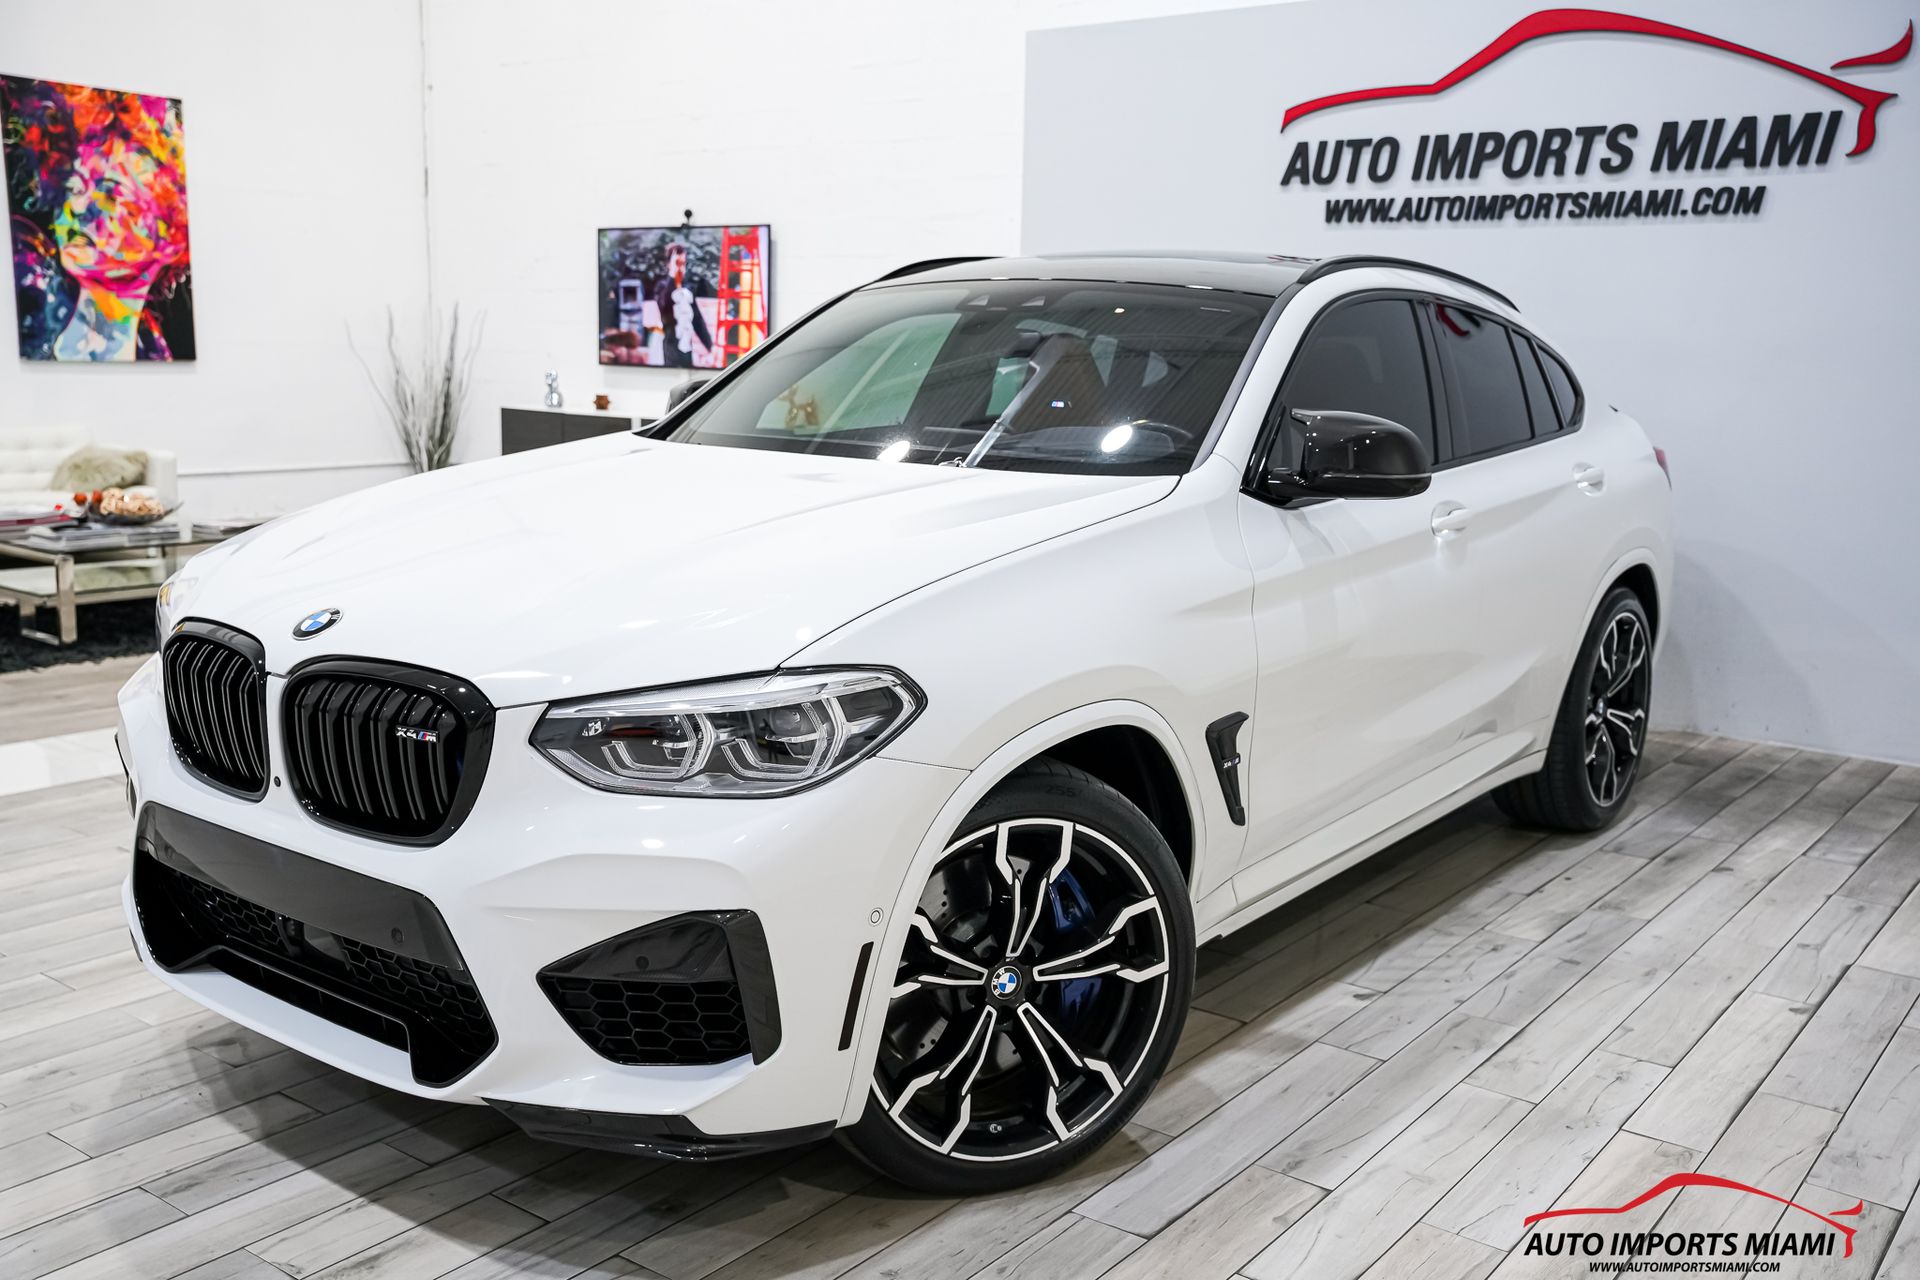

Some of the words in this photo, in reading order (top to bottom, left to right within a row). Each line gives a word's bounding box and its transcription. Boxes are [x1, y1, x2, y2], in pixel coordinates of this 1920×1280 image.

[1281, 137, 1399, 185] AUTO
[1411, 124, 1637, 181] IMPORTS
[1650, 111, 1843, 172] MIAMI
[1325, 186, 1767, 223] WWW.AUTOIMPORTSMIAMI.COM
